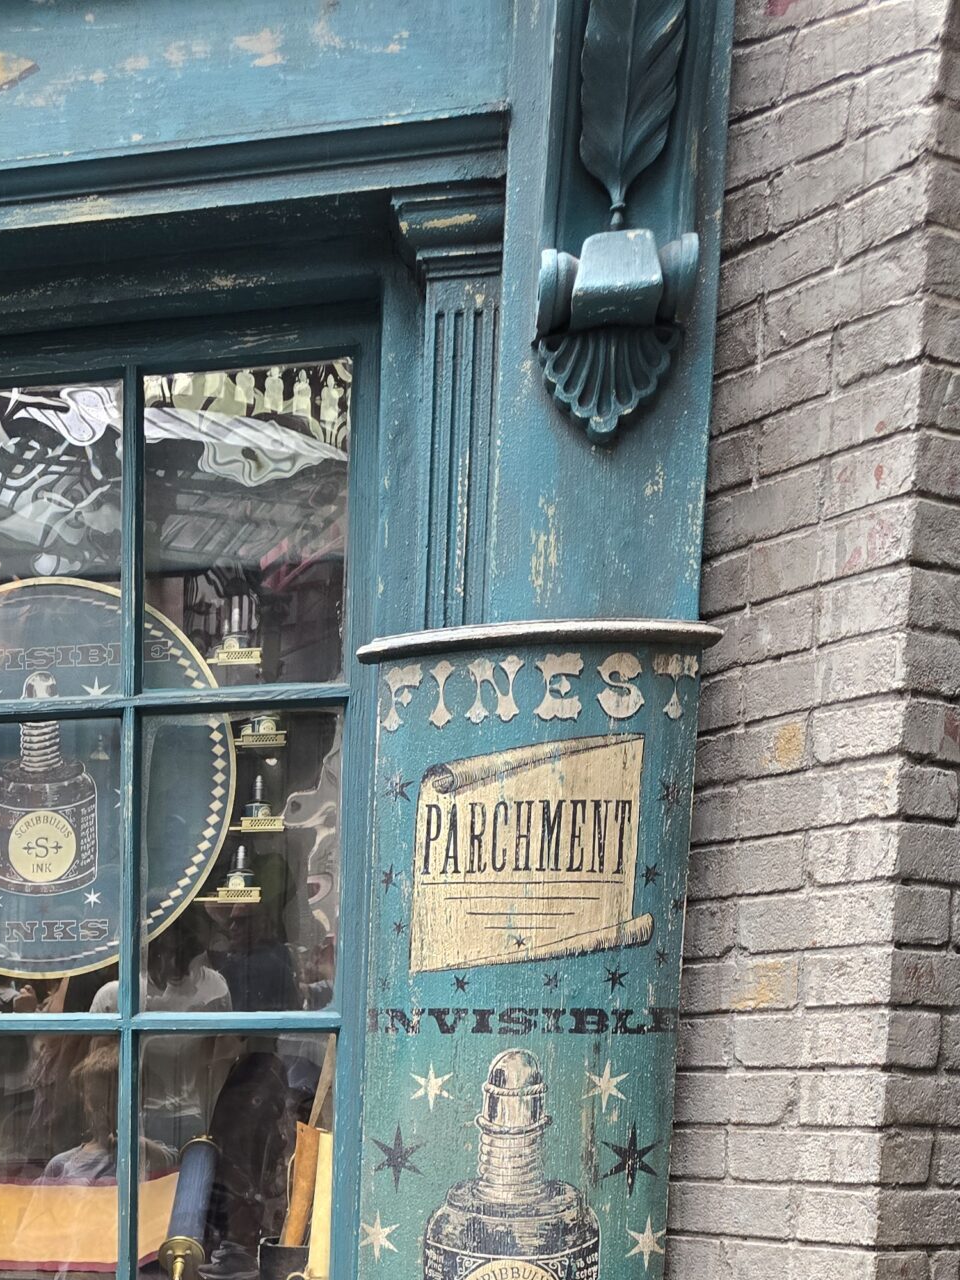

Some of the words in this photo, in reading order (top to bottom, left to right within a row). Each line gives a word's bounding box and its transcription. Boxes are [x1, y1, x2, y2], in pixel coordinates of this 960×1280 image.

[381, 652, 700, 732] FINEST
[14, 815, 73, 839] SCRIBBULUS
[420, 799, 633, 875] PARCHMENT
[35, 837, 49, 858] S
[31, 862, 52, 873] INK
[367, 1007, 679, 1035] INVISIBLE
